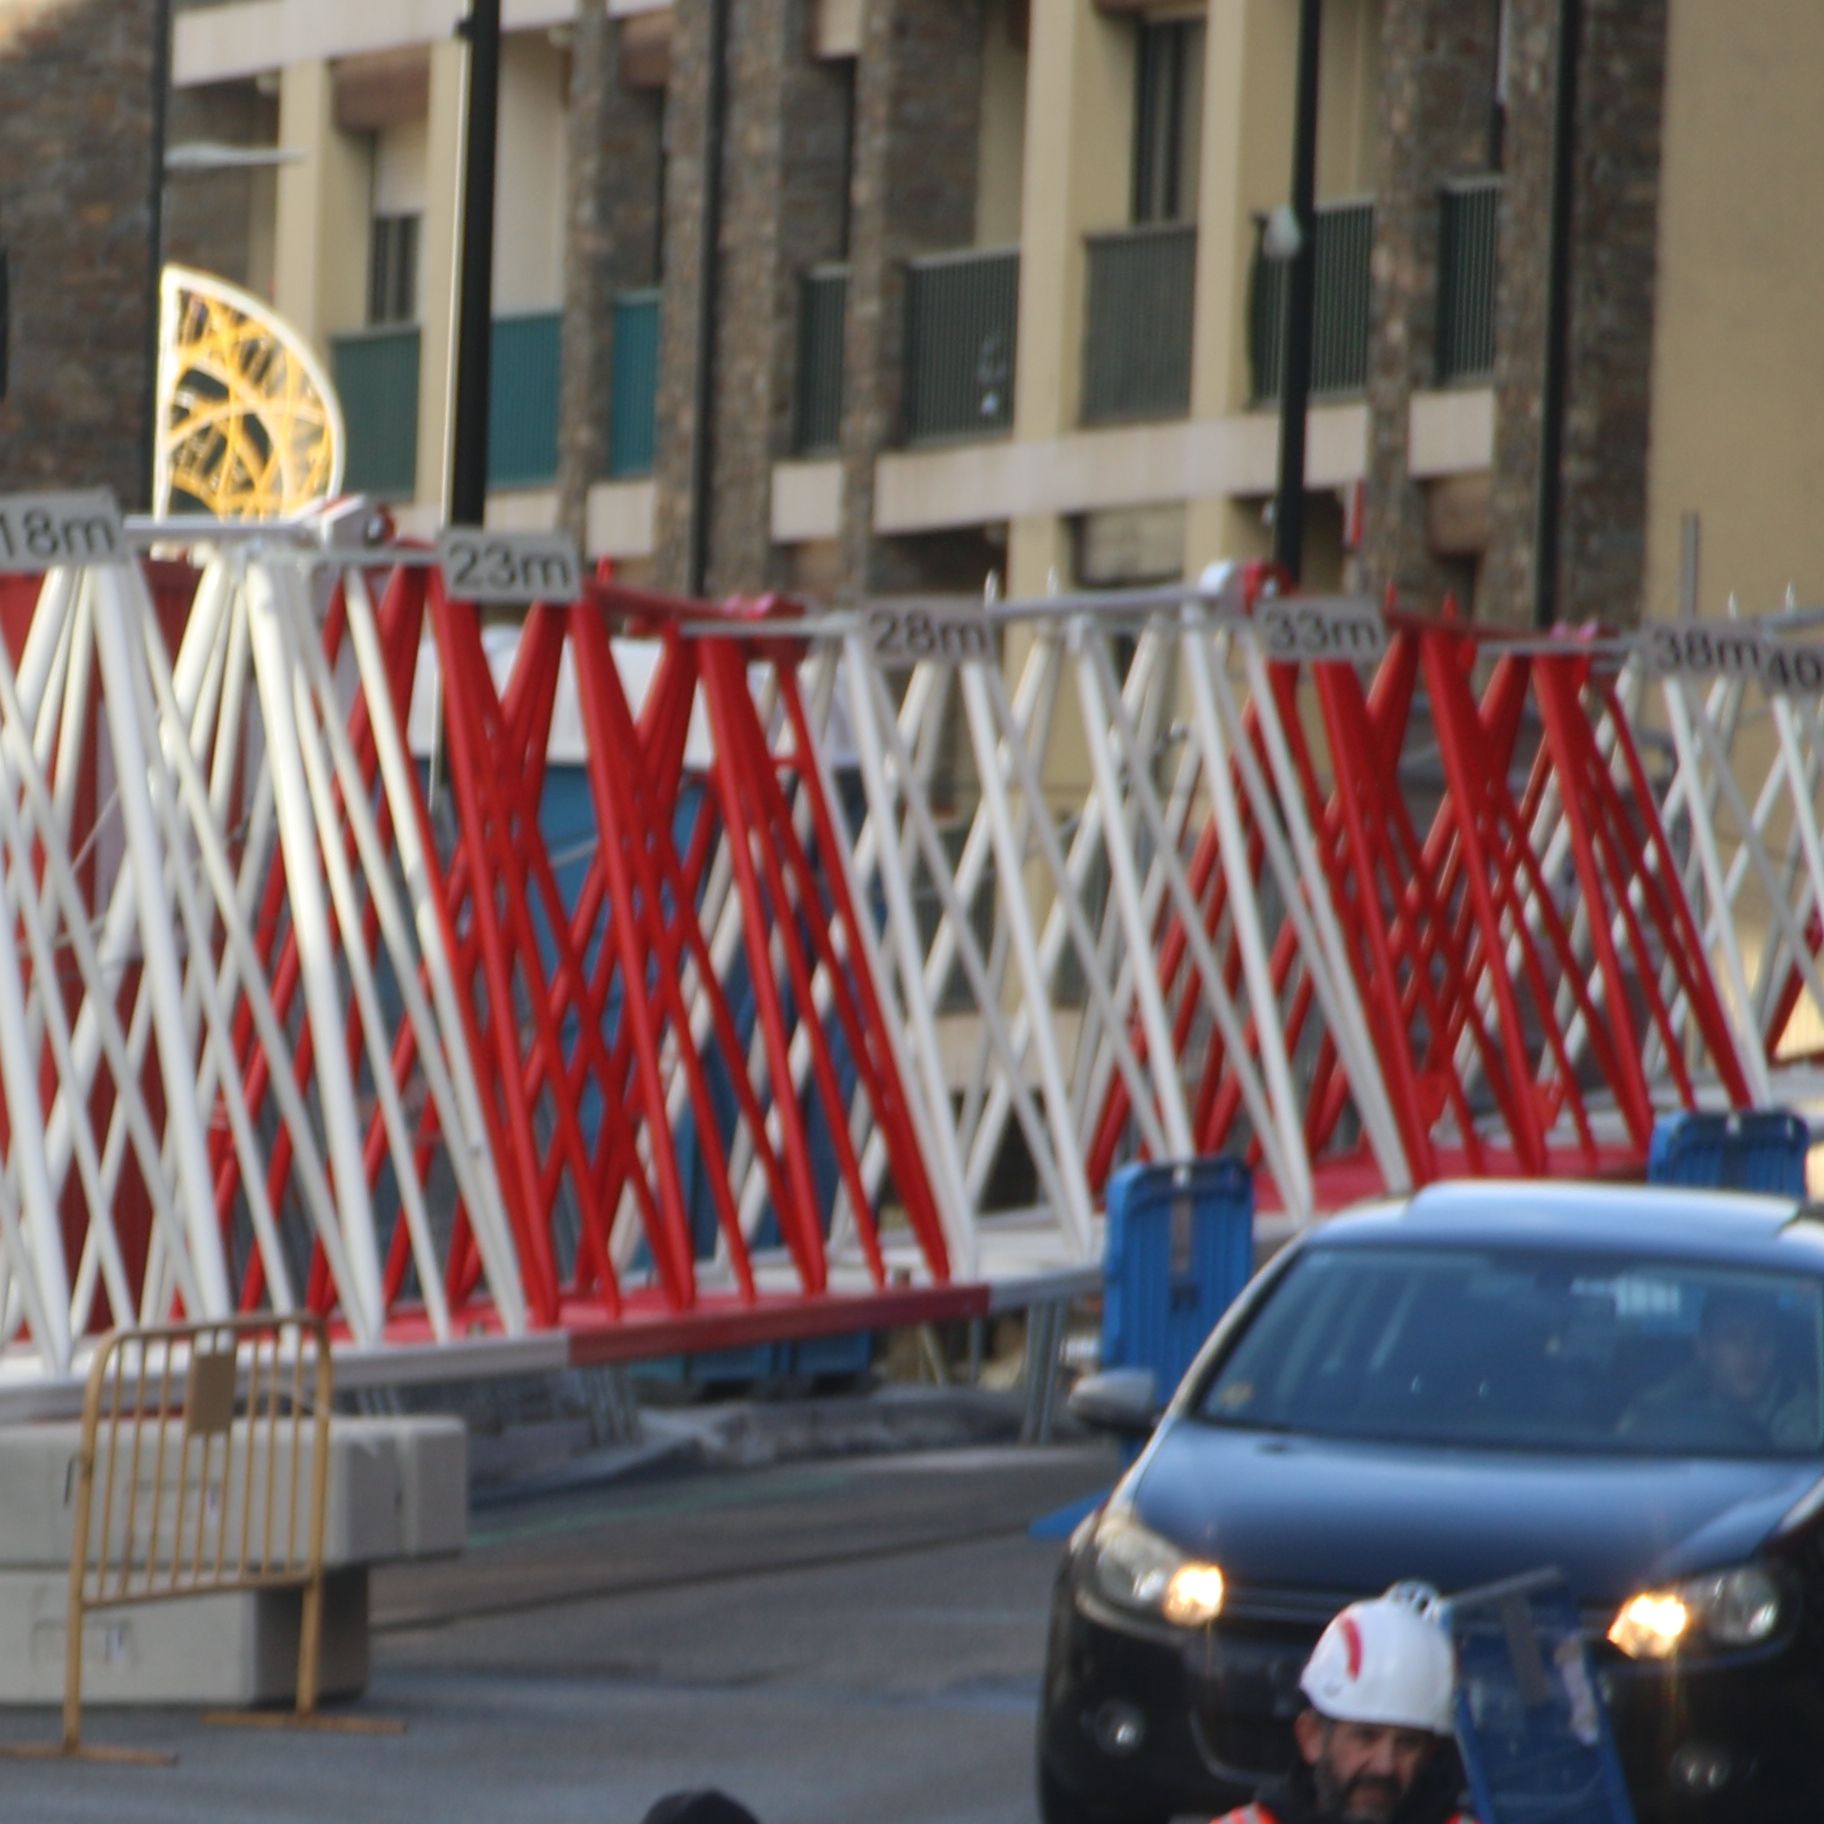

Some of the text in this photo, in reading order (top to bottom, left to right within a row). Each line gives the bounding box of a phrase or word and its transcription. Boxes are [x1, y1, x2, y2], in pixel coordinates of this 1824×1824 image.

[449, 539, 570, 590] 23m
[868, 607, 989, 655] 28m
[1265, 608, 1378, 651] 33m
[1652, 625, 1761, 671] 38m
